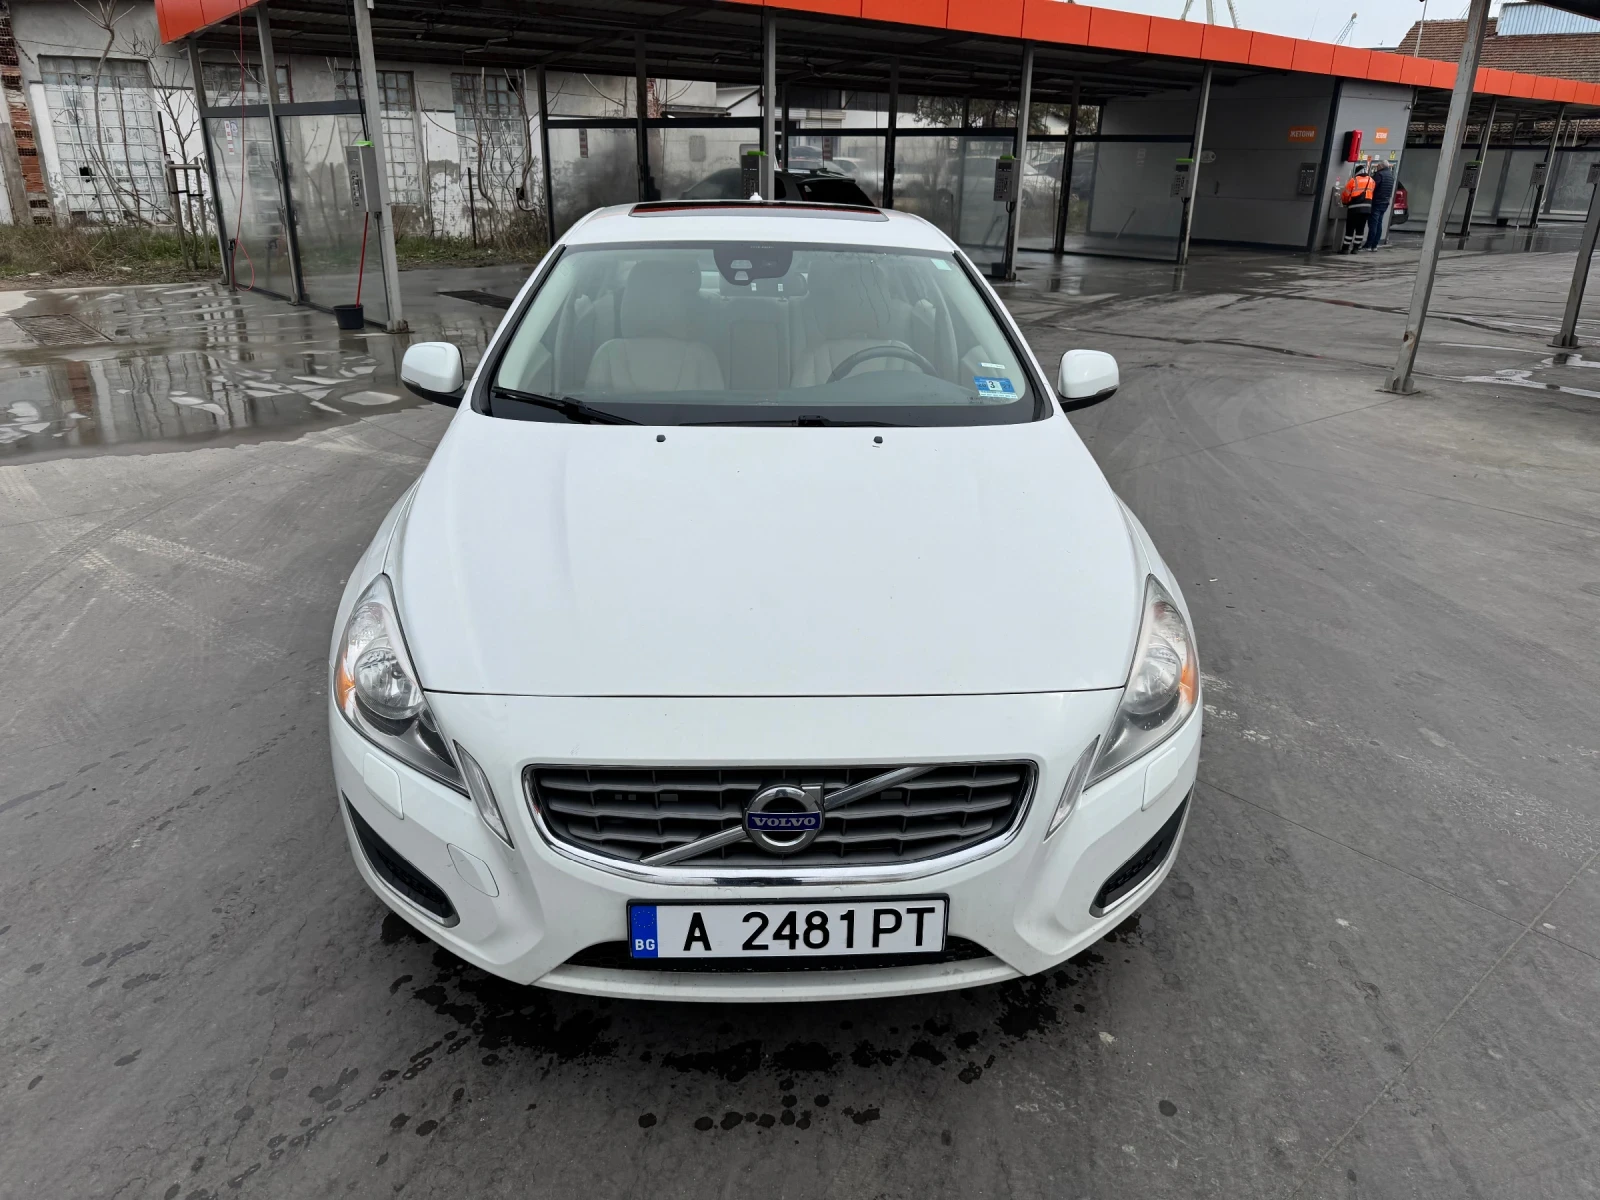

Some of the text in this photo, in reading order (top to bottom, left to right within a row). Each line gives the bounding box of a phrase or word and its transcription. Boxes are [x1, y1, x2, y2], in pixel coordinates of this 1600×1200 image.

[988, 380, 996, 388] 3
[751, 816, 816, 827] VOLVO
[683, 911, 712, 951] A
[634, 938, 656, 951] BG
